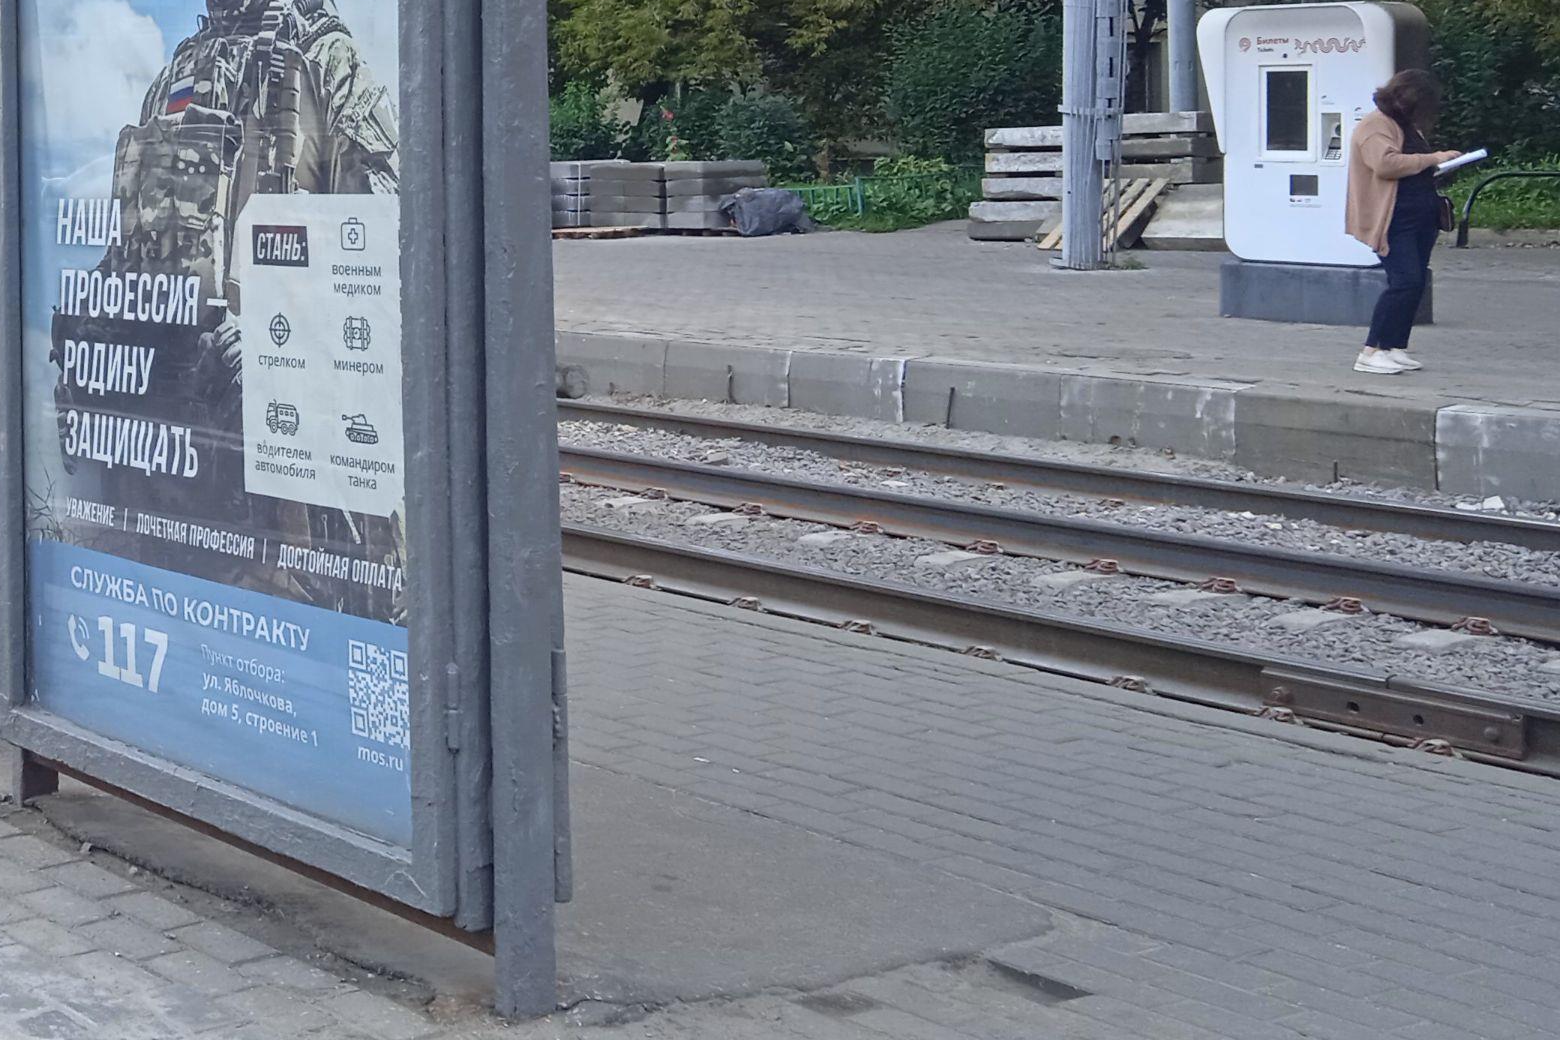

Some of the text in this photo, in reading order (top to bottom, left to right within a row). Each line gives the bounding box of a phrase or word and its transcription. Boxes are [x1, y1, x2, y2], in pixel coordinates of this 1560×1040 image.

[1256, 36, 1289, 45] Билеты
[57, 198, 122, 246] НАША
[256, 232, 306, 261] СТАНЬ:
[332, 264, 382, 277] военным
[60, 269, 201, 326] ПРОФЕССИЯ
[333, 282, 382, 297] медиком
[63, 339, 155, 396] РОДИНУ
[258, 354, 306, 370] стрелком
[333, 359, 384, 376] минером
[65, 410, 199, 478] ЗАЩИЩАТЬ
[256, 442, 312, 461] водителем
[255, 460, 316, 480] автомобиля
[330, 453, 395, 474] командиром
[348, 475, 377, 490] танка
[66, 496, 403, 592] УВАЖЕНИЕ ПОЧЕТНАЯ ПРОФЕССИЯ ДОСТОЙНАЯ ОПЛАТА
[70, 565, 310, 652] СЛУЖБА ПО КОНТРАКТУ
[97, 615, 168, 693] 117
[200, 644, 286, 684] Пункт отбора:
[202, 672, 297, 718] ул. Яблочкова,
[201, 697, 319, 747] дом 5, строение 1
[357, 745, 404, 772] mos.ru
